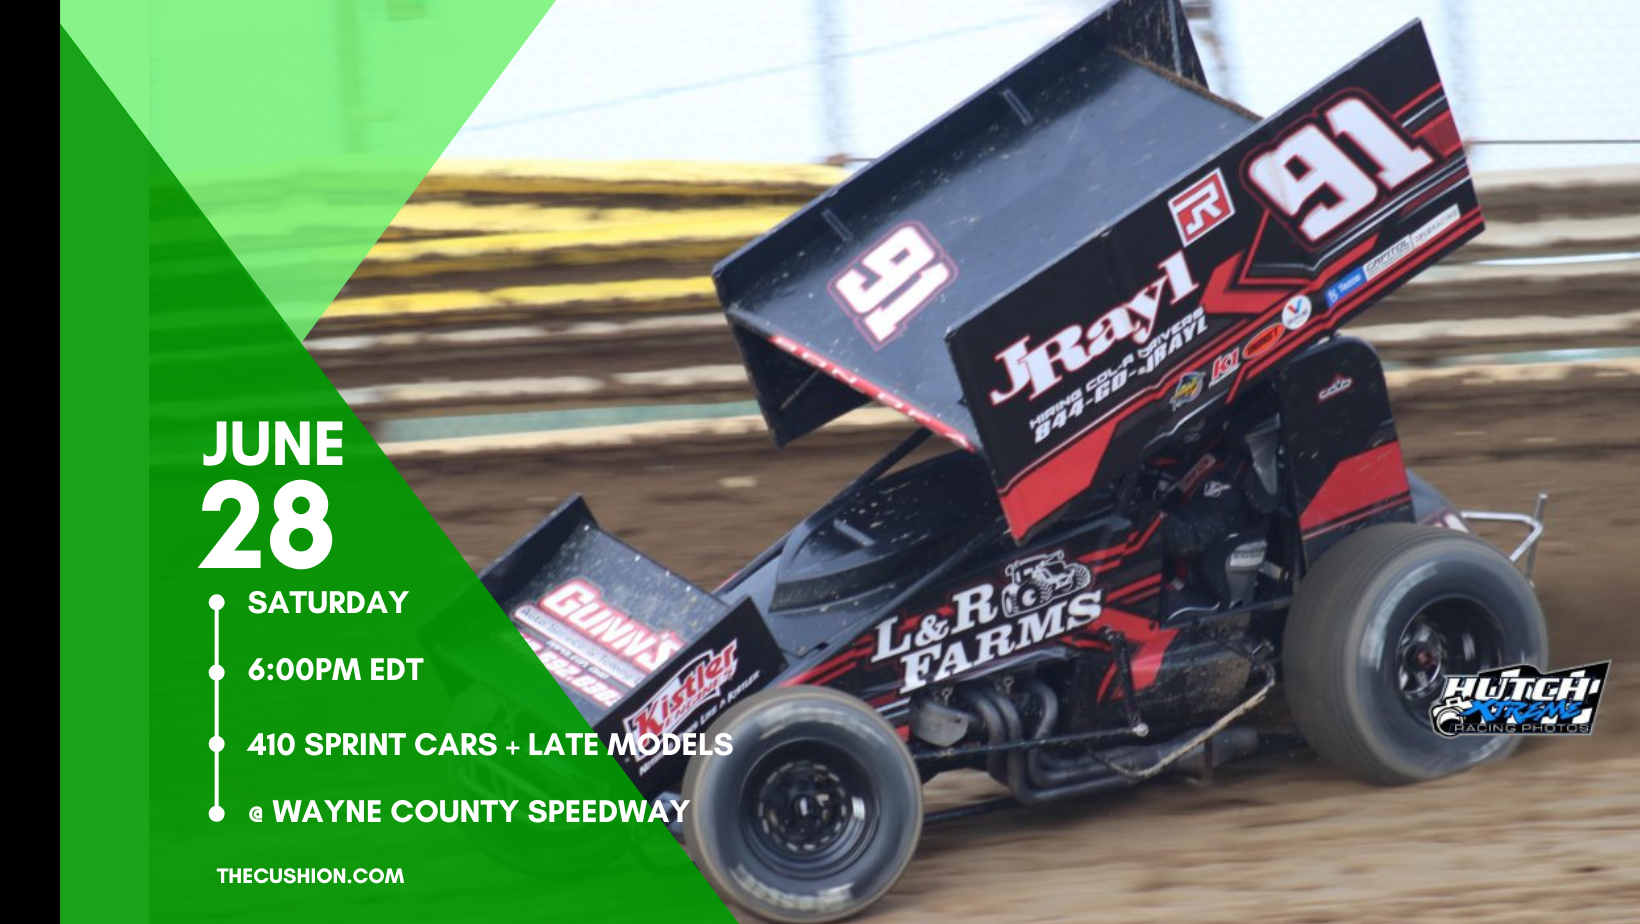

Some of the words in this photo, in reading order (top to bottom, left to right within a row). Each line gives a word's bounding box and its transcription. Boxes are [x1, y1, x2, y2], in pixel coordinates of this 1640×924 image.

[1248, 97, 1434, 242] 91
[835, 226, 950, 343] 91
[1366, 238, 1410, 272] CAPITOL
[991, 250, 1199, 408] JRayl
[1029, 388, 1083, 430] HIRING
[1137, 306, 1205, 358] DRIVERS
[870, 582, 999, 663] L&R
[900, 589, 1102, 694] FARMS
[632, 645, 737, 748] Kistler
